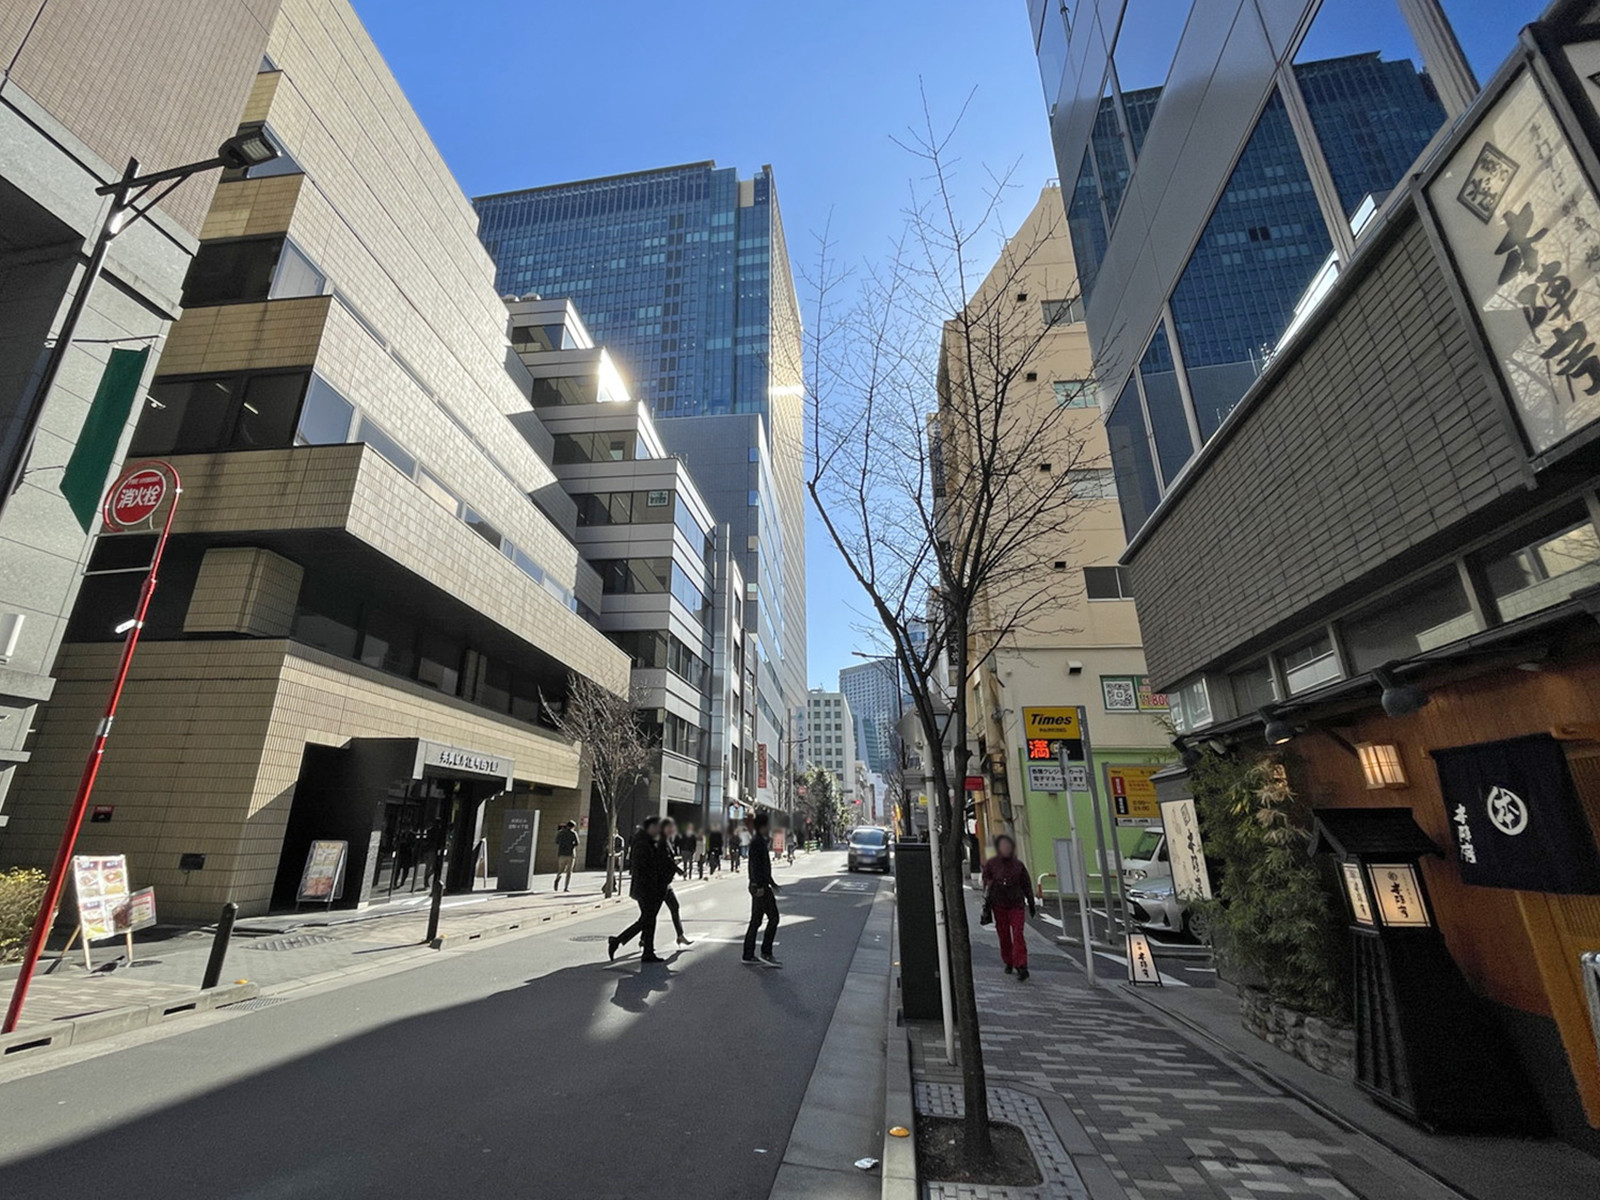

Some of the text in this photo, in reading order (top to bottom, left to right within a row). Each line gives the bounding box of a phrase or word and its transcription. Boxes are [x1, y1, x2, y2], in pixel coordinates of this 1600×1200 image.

[116, 485, 161, 509] 消火栓
[1031, 714, 1072, 725] Times
[1028, 739, 1050, 758] 満
